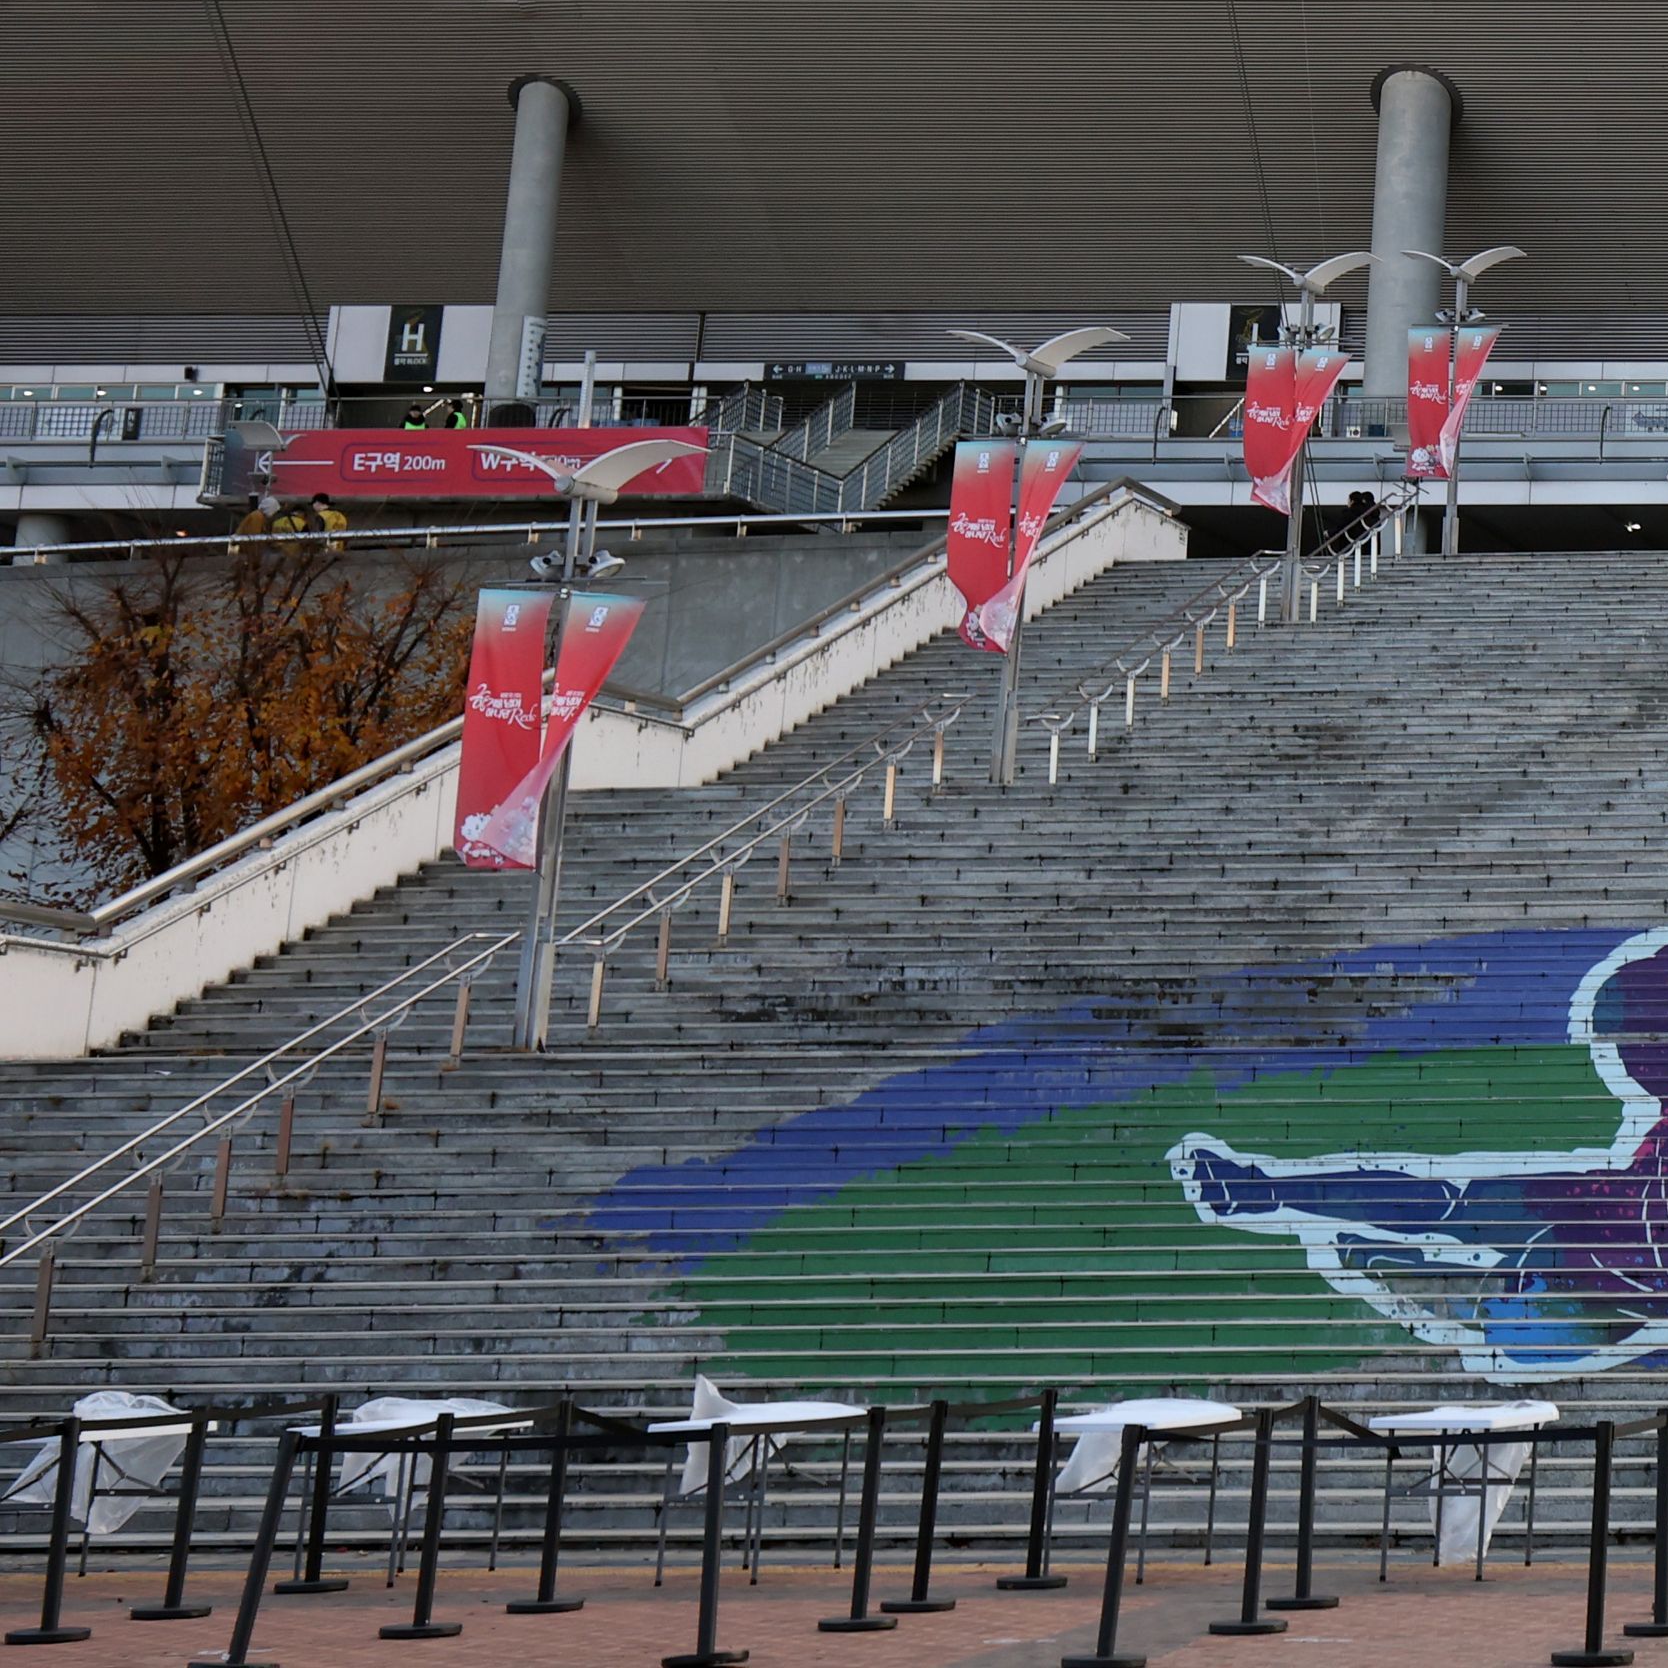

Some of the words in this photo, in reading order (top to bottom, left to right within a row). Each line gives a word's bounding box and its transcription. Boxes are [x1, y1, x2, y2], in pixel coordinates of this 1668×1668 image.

[402, 323, 424, 352] H
[353, 452, 401, 473] E구역
[403, 456, 446, 471] 200m
